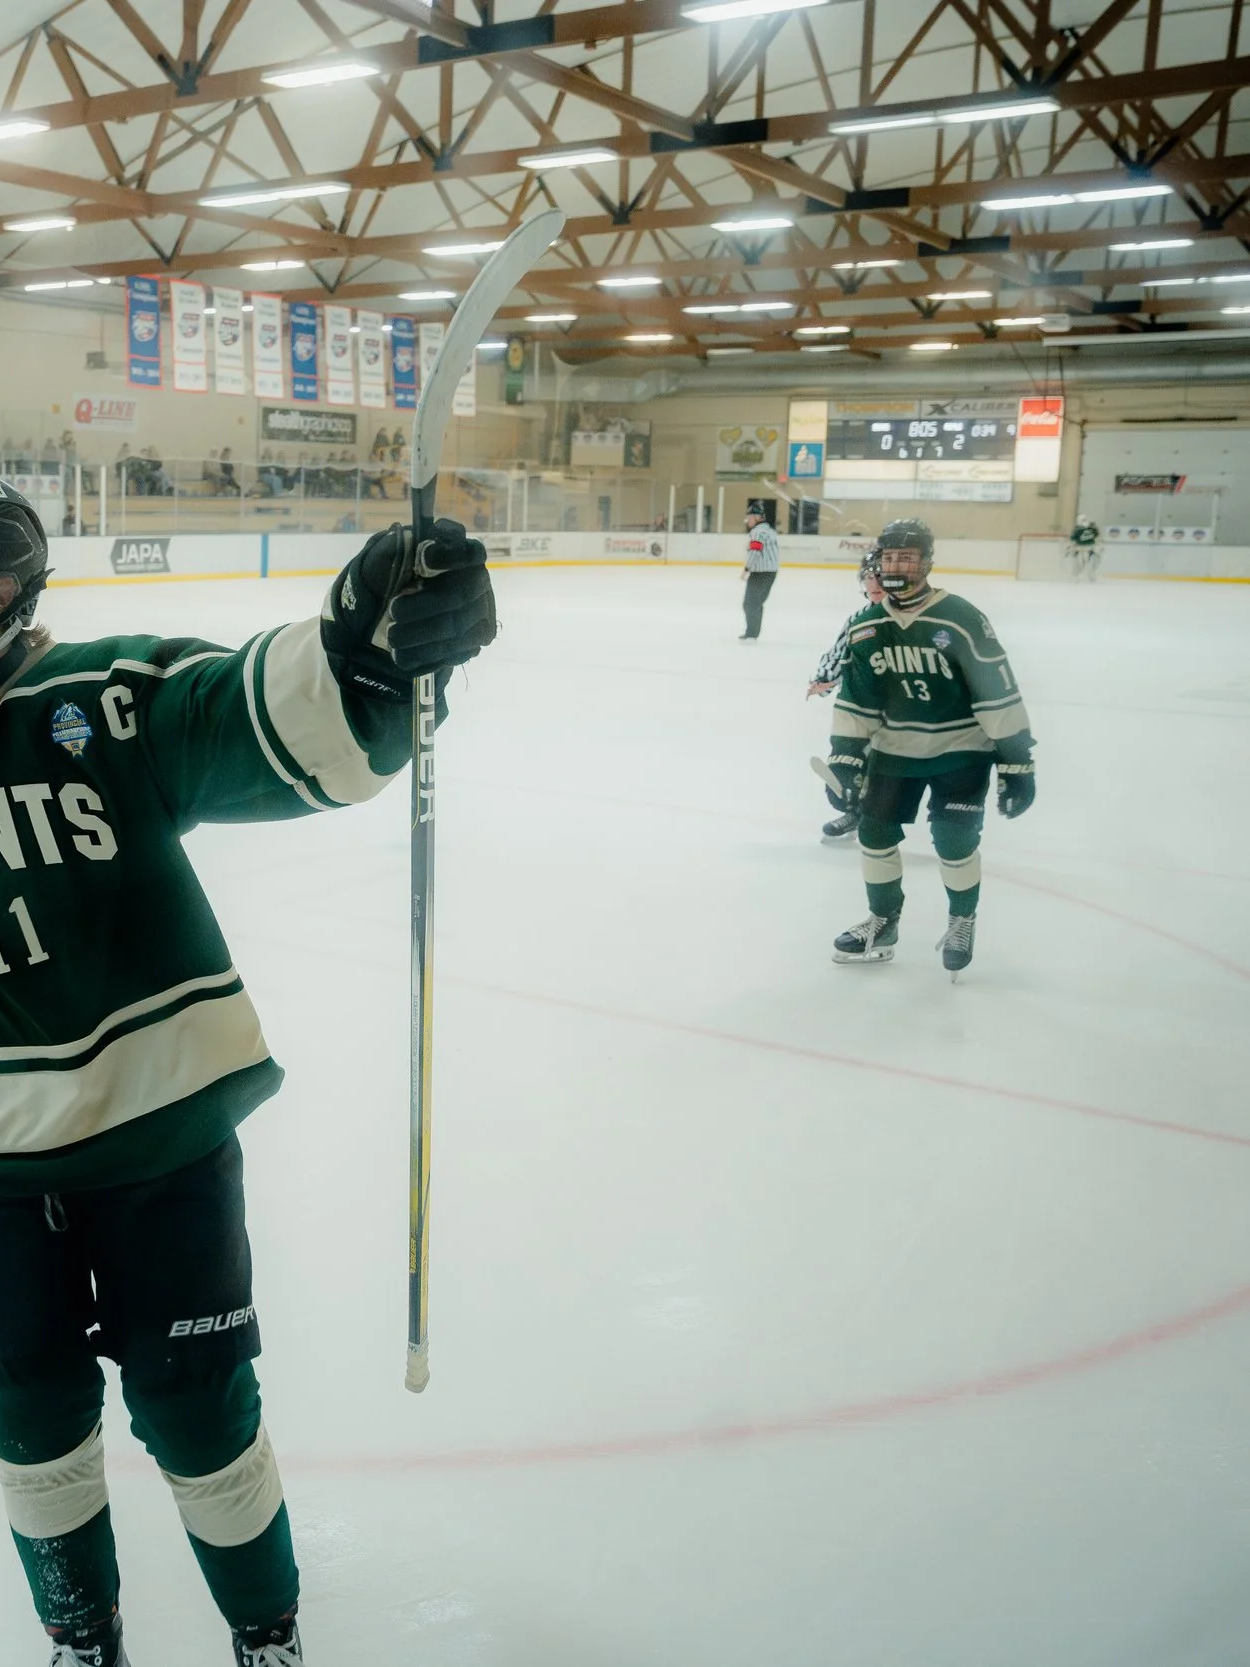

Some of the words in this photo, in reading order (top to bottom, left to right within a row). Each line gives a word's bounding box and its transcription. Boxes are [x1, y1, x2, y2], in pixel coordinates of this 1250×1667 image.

[74, 398, 136, 424] Q-LINE
[952, 434, 966, 450] 2
[116, 543, 164, 564] JAPA
[869, 645, 953, 680] SAINTS
[900, 679, 931, 702] 13
[52, 718, 87, 731] PROVINCIAL
[100, 684, 138, 741] C
[168, 1304, 255, 1339] BAUER
